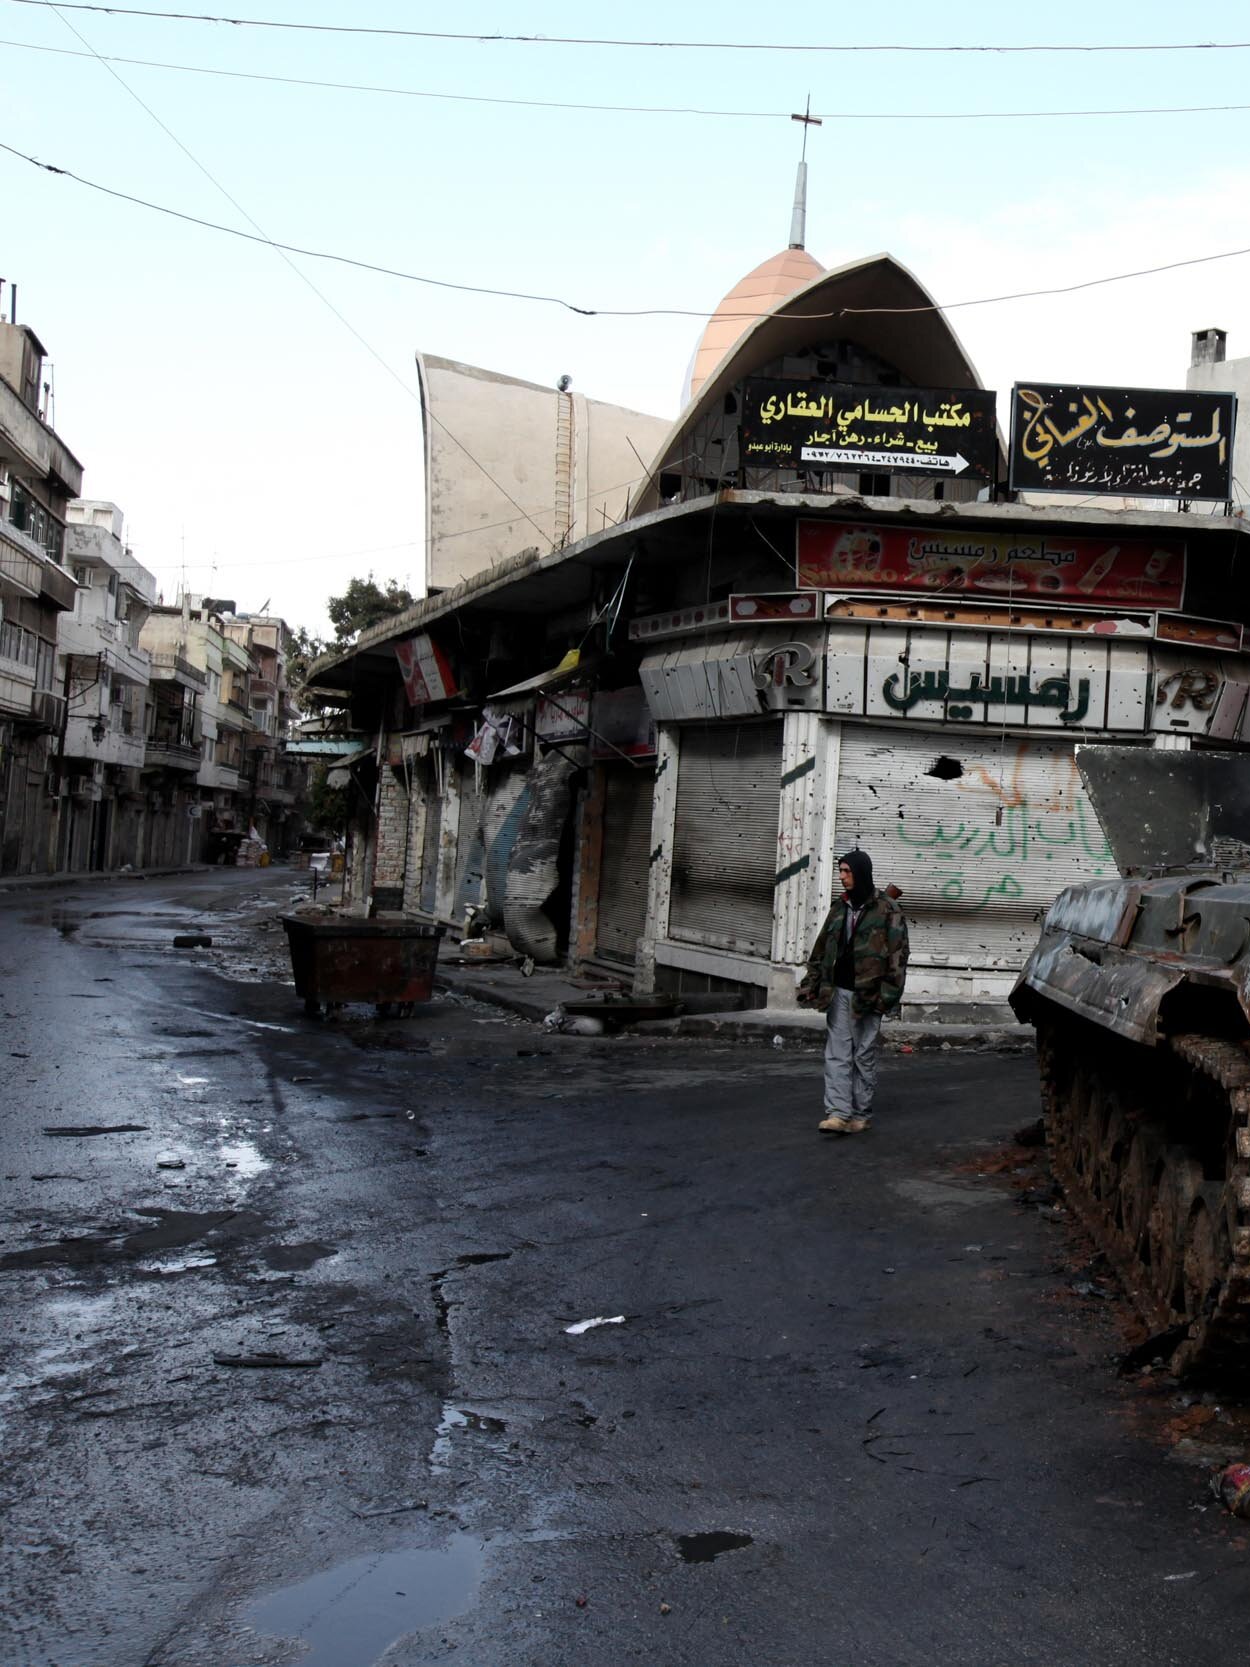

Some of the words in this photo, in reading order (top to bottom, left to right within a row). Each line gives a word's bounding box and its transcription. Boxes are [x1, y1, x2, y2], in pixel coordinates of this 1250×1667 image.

[759, 391, 834, 425] العقاري
[836, 398, 919, 432] الحسامي
[922, 402, 971, 433] مكتب
[873, 431, 905, 448] شراء
[914, 439, 939, 454] بيع
[919, 456, 951, 467] هاتف
[908, 537, 999, 563] رمسيس
[1007, 540, 1076, 566] مطعم
[881, 669, 1090, 722] رمسيس
